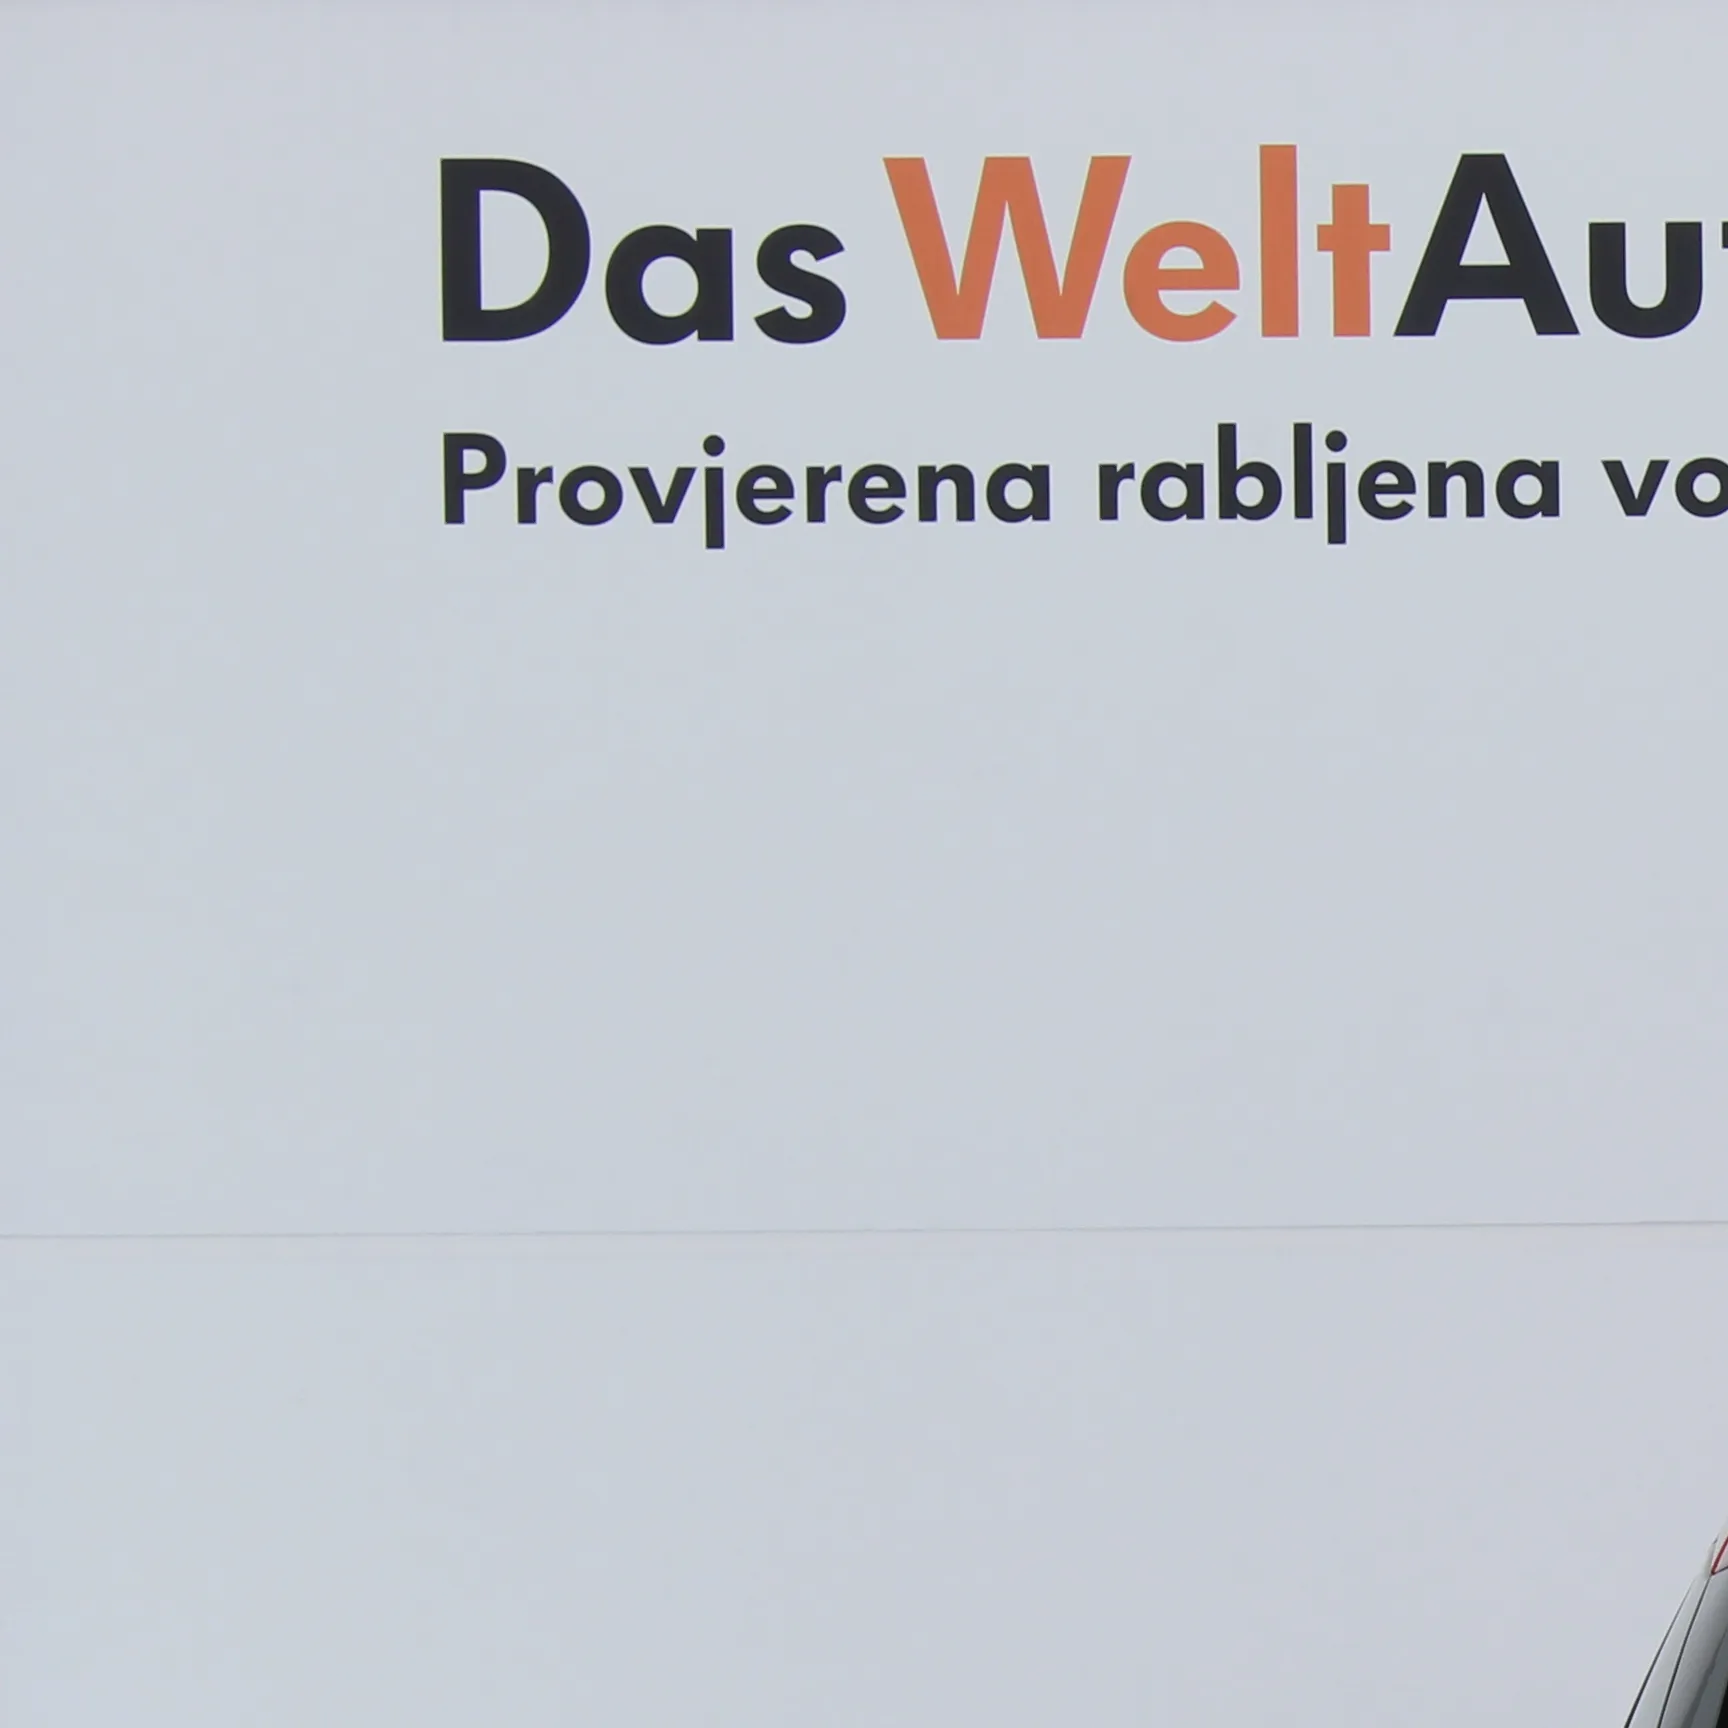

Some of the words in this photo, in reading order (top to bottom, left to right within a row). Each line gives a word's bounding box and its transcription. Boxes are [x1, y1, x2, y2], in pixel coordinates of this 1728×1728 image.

[441, 159, 847, 346] Das
[444, 434, 1051, 550] Provjerena
[1100, 424, 1560, 545] rabljena
